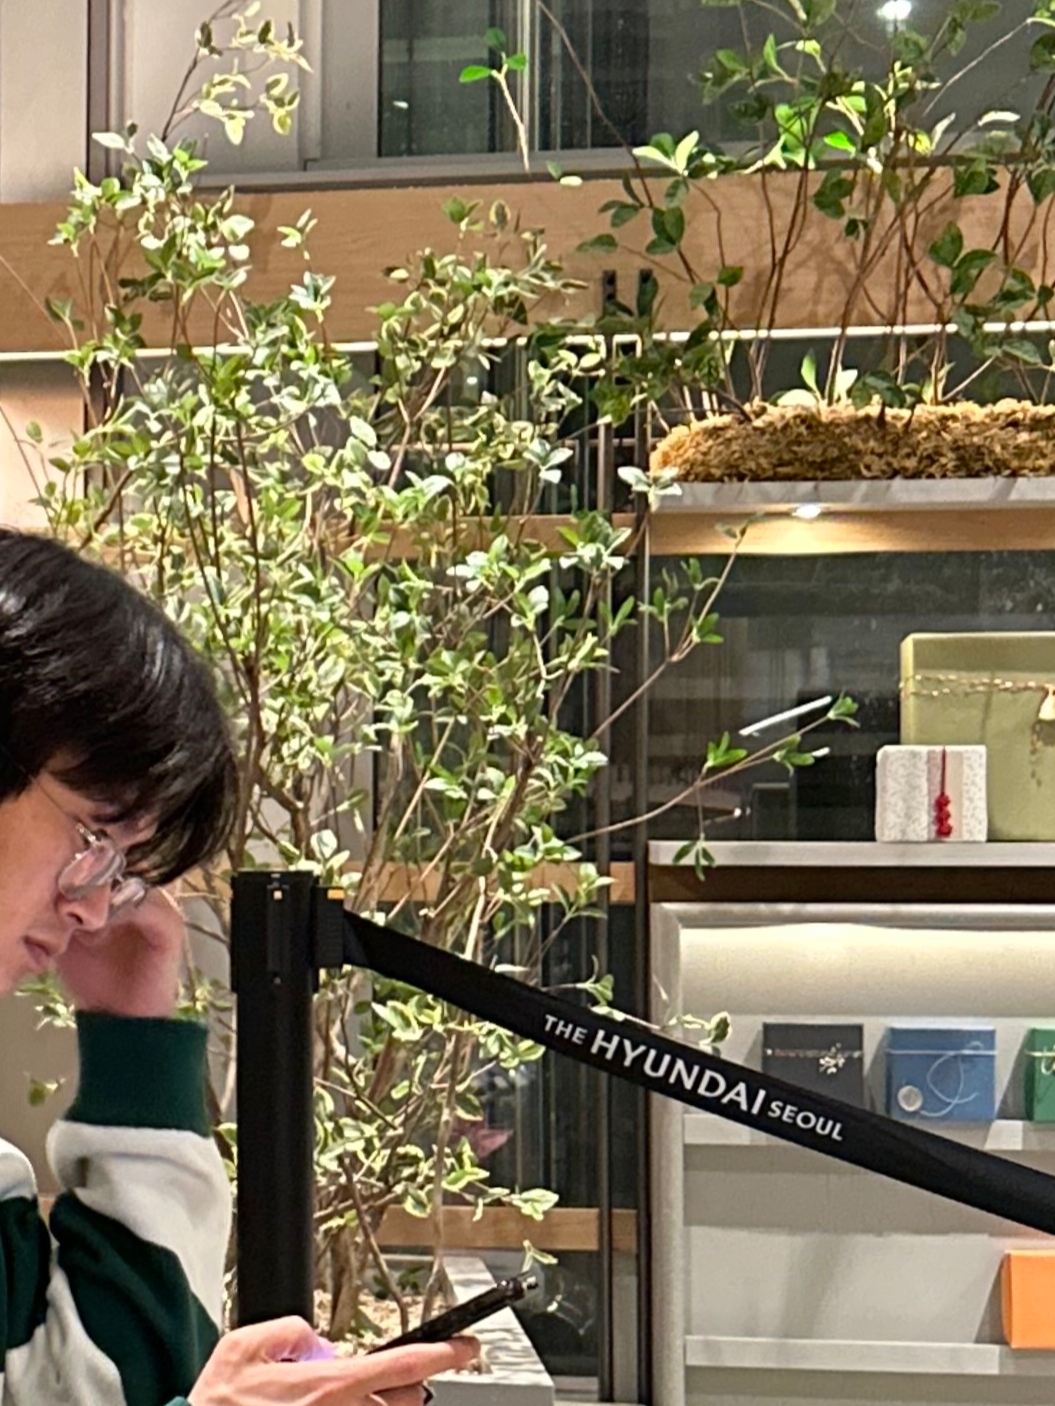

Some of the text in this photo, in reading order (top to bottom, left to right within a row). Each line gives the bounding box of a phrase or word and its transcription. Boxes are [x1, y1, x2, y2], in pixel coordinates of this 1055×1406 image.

[545, 1014, 843, 1141] THE HYUNDAI SEOUL
